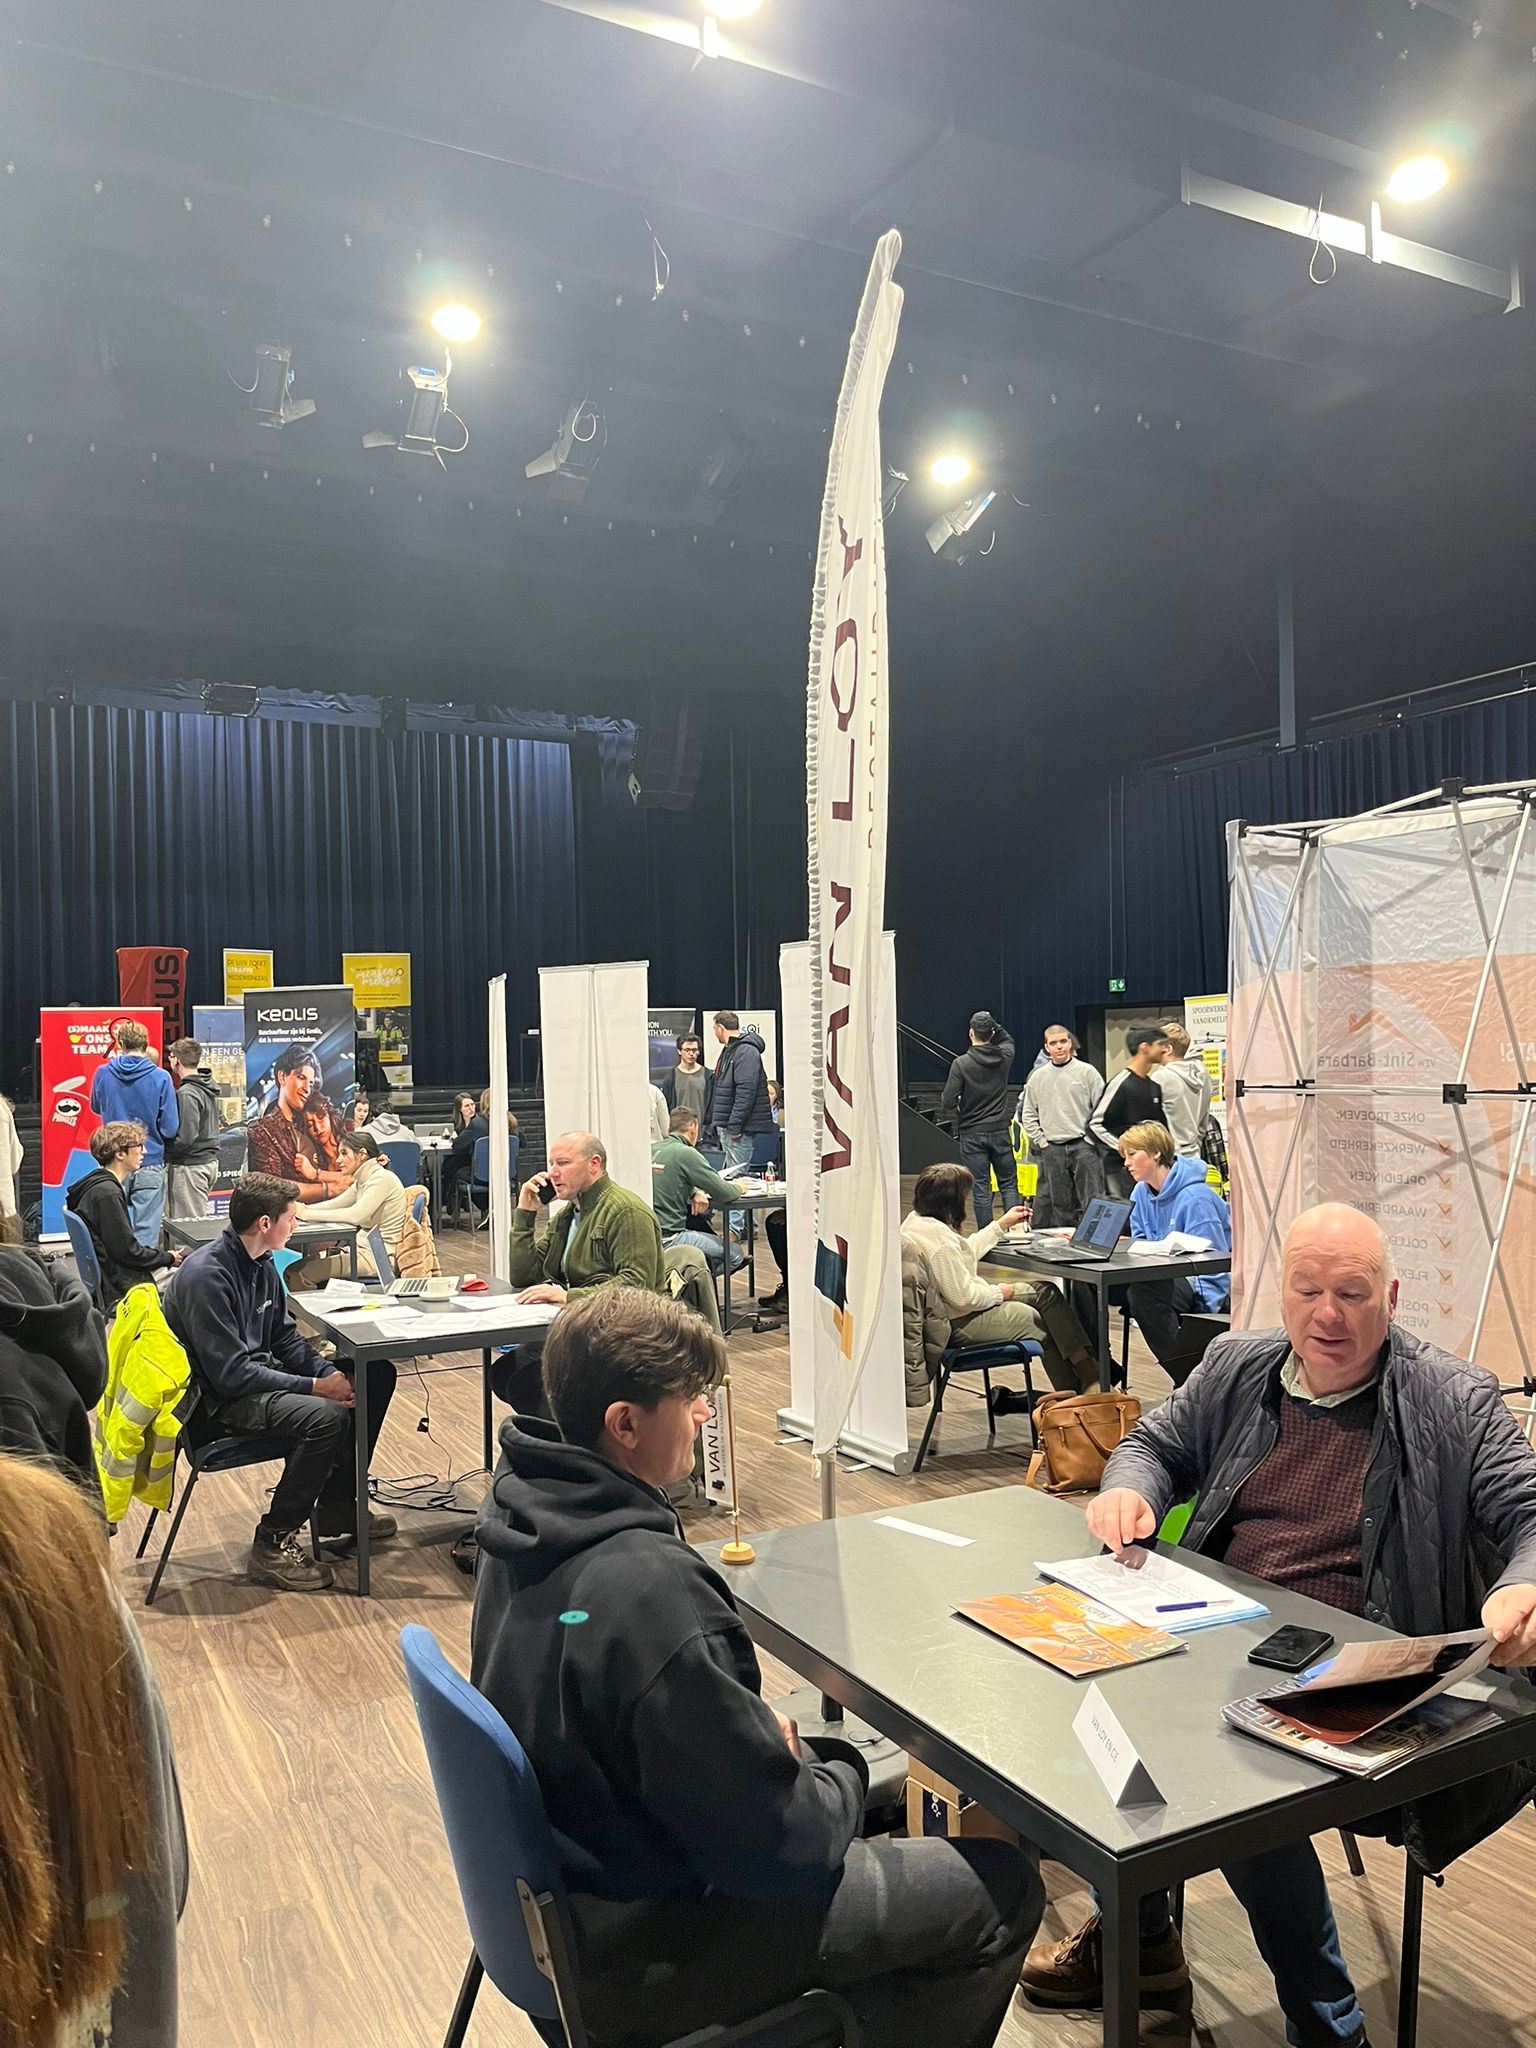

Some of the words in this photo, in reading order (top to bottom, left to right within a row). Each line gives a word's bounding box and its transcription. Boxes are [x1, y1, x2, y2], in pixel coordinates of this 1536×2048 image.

[831, 515, 863, 821] LOY
[67, 1025, 110, 1034] (S)MAAK
[85, 1034, 112, 1044] ONS
[821, 881, 852, 1174] VAN
[71, 1045, 107, 1054] TEAM
[708, 1434, 720, 1473] VAN
